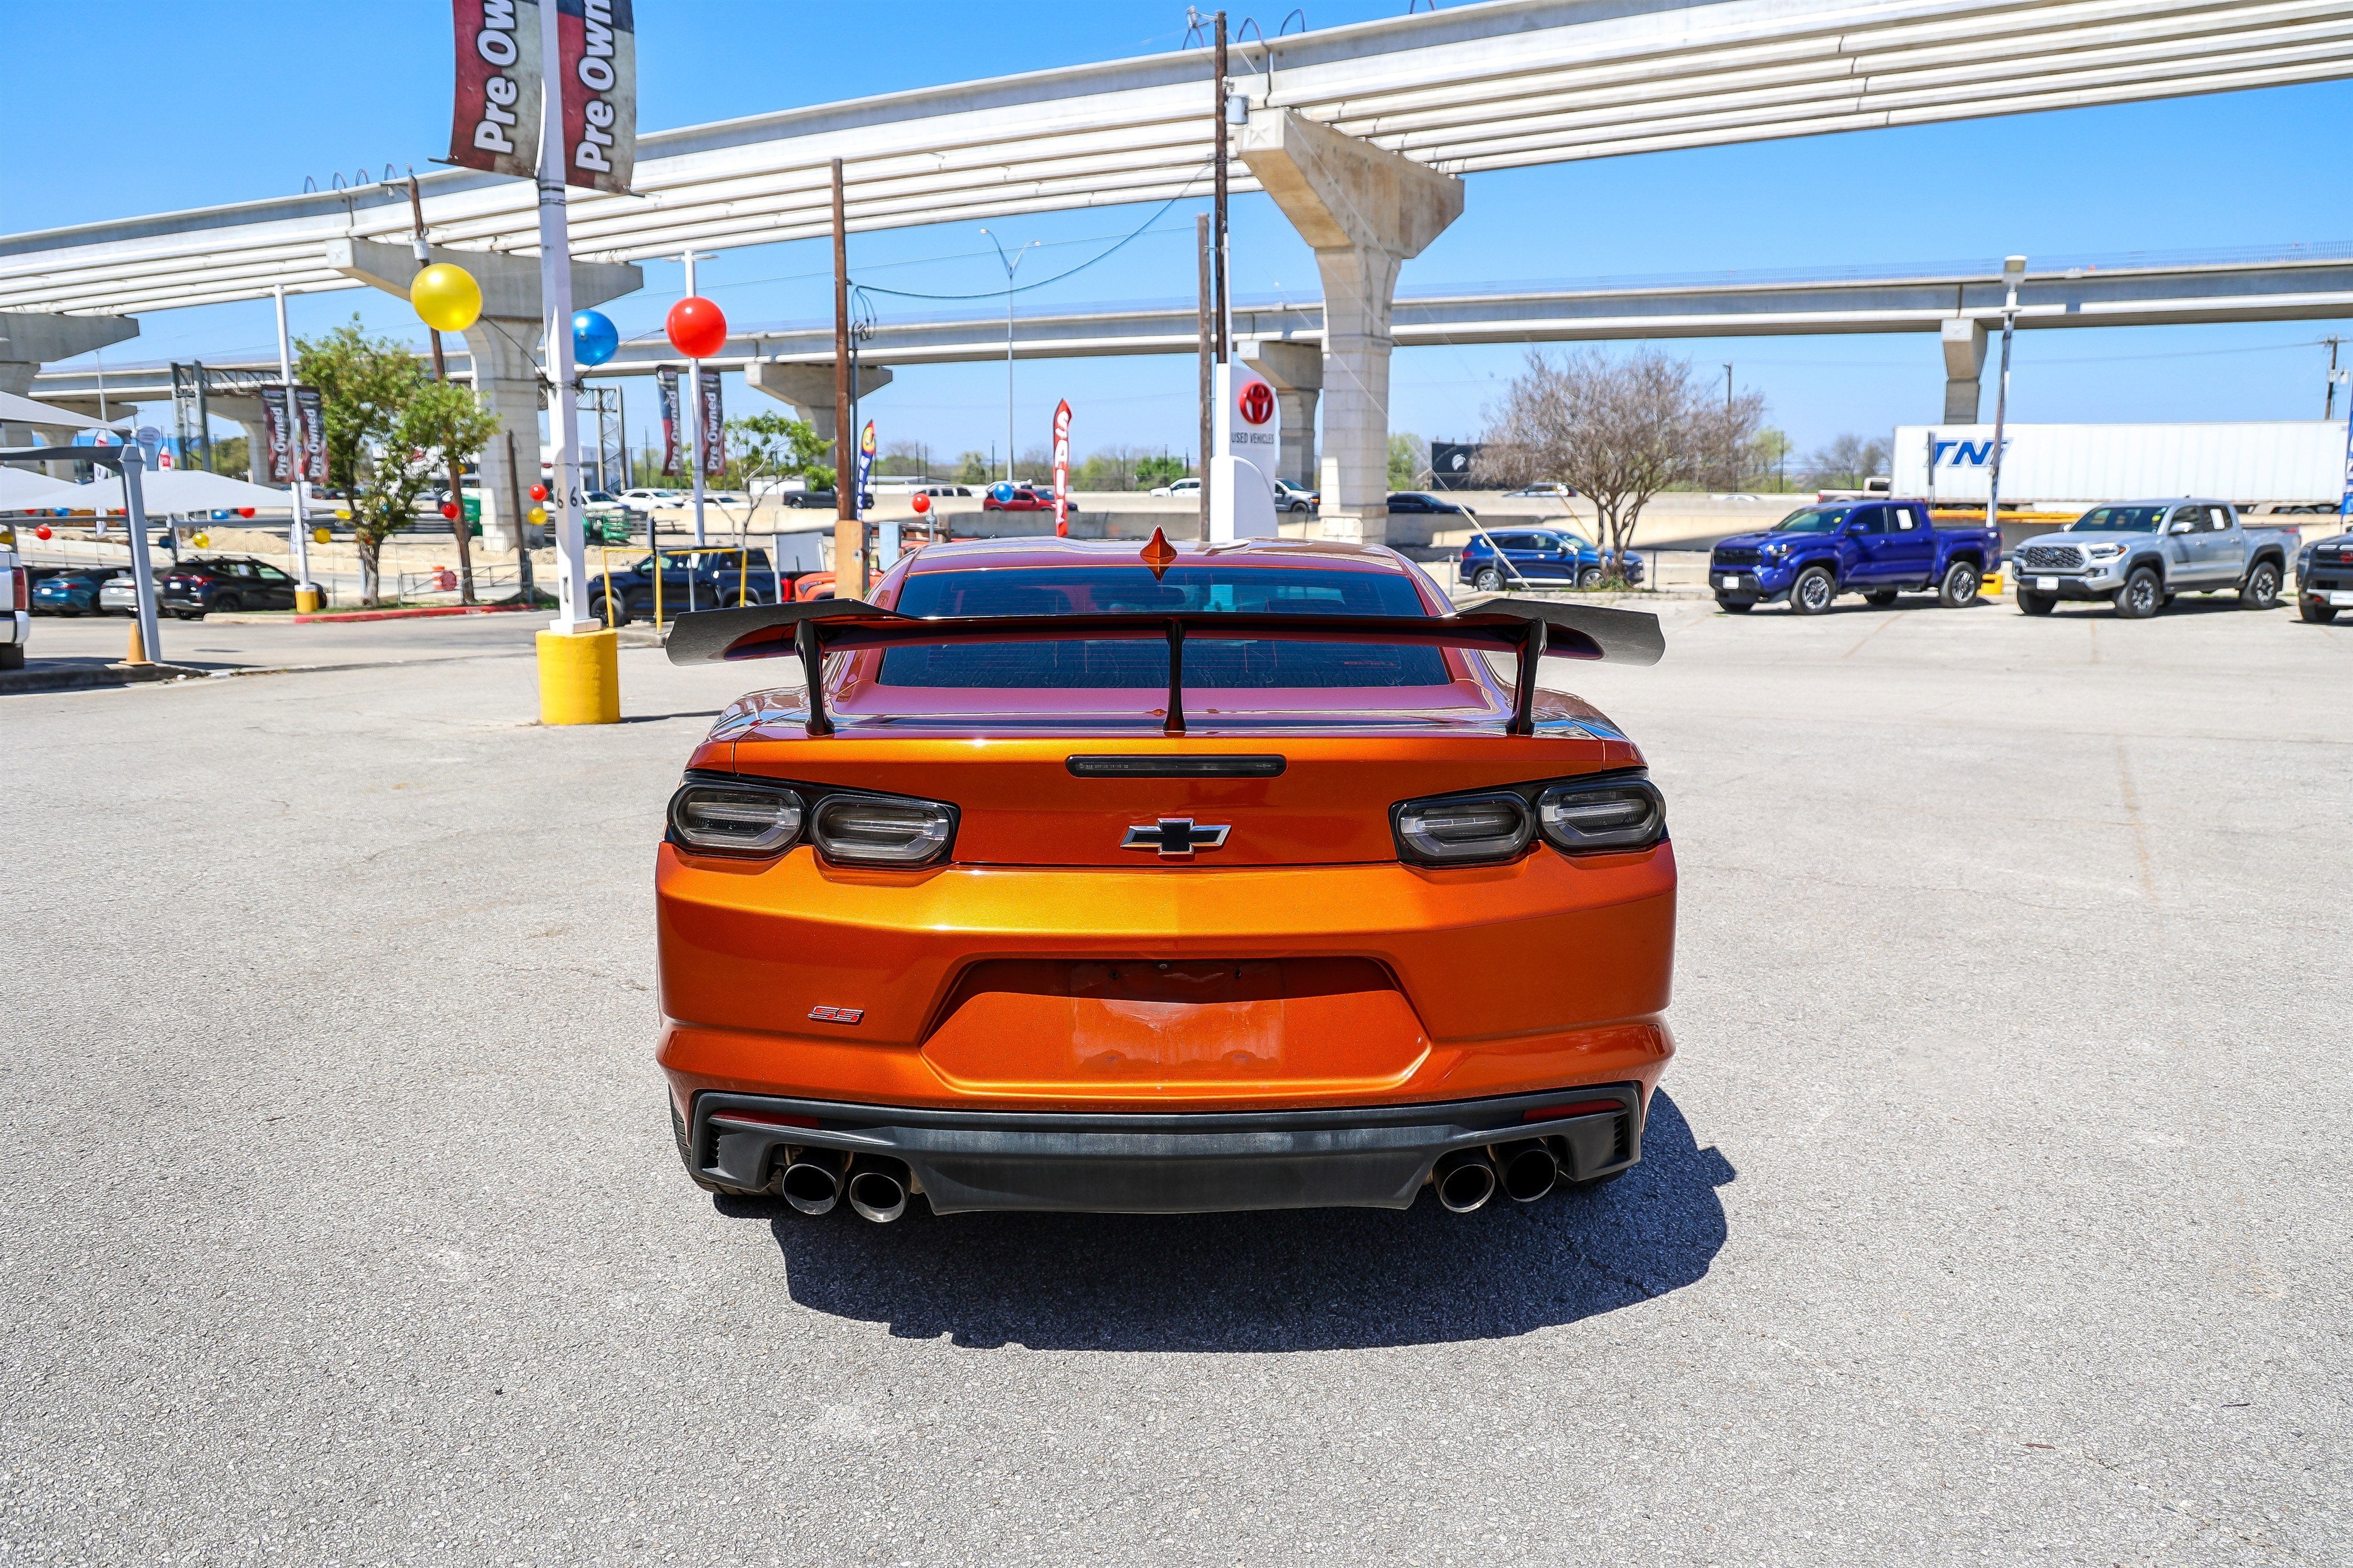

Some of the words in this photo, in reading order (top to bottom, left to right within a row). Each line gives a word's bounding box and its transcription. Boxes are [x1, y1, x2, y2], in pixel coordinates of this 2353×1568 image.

[474, 76, 518, 153] Pre
[575, 100, 615, 172] Pre
[269, 407, 287, 453] Owned
[303, 408, 320, 453] Owned
[666, 391, 679, 442] Owned
[705, 392, 718, 443] Owned
[1231, 432, 1248, 443] USED
[275, 455, 287, 477] Pre
[308, 455, 321, 477] Pre
[668, 445, 679, 469] Pre
[707, 445, 718, 469] Pre
[808, 1006, 863, 1023] SS
